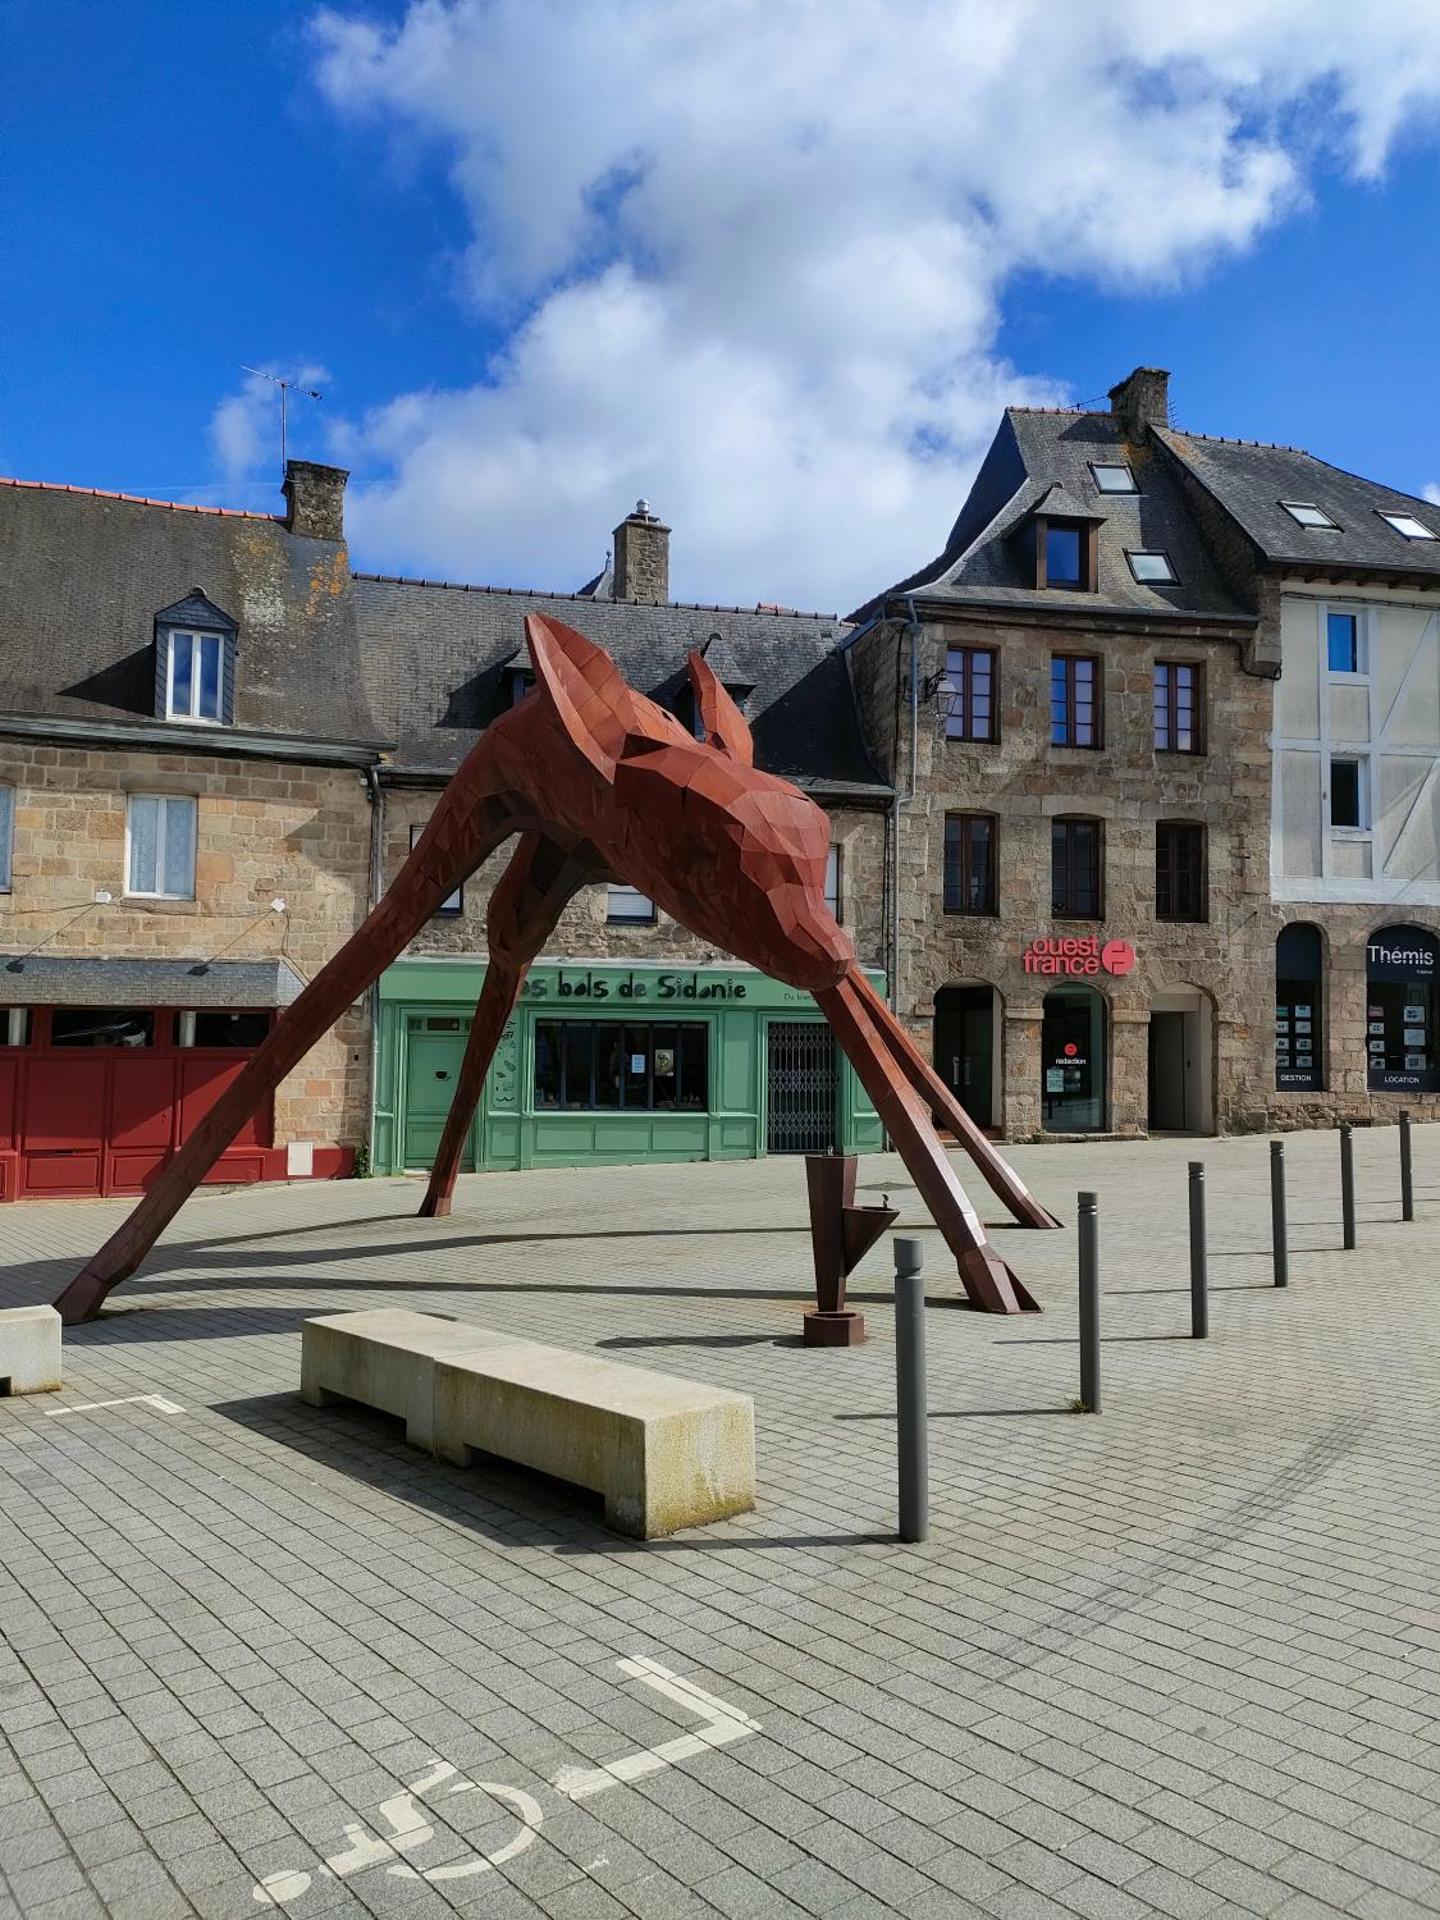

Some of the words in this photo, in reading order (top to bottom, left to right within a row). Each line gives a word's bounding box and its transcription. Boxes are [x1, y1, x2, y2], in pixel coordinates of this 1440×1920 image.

[1032, 935, 1099, 956] ouest
[1367, 944, 1434, 965] Thémis
[1023, 951, 1101, 974] france
[618, 972, 647, 997] de
[656, 973, 746, 998] Sidonie
[1280, 1074, 1312, 1082] GESTION
[1384, 1075, 1420, 1084] LOCATION
